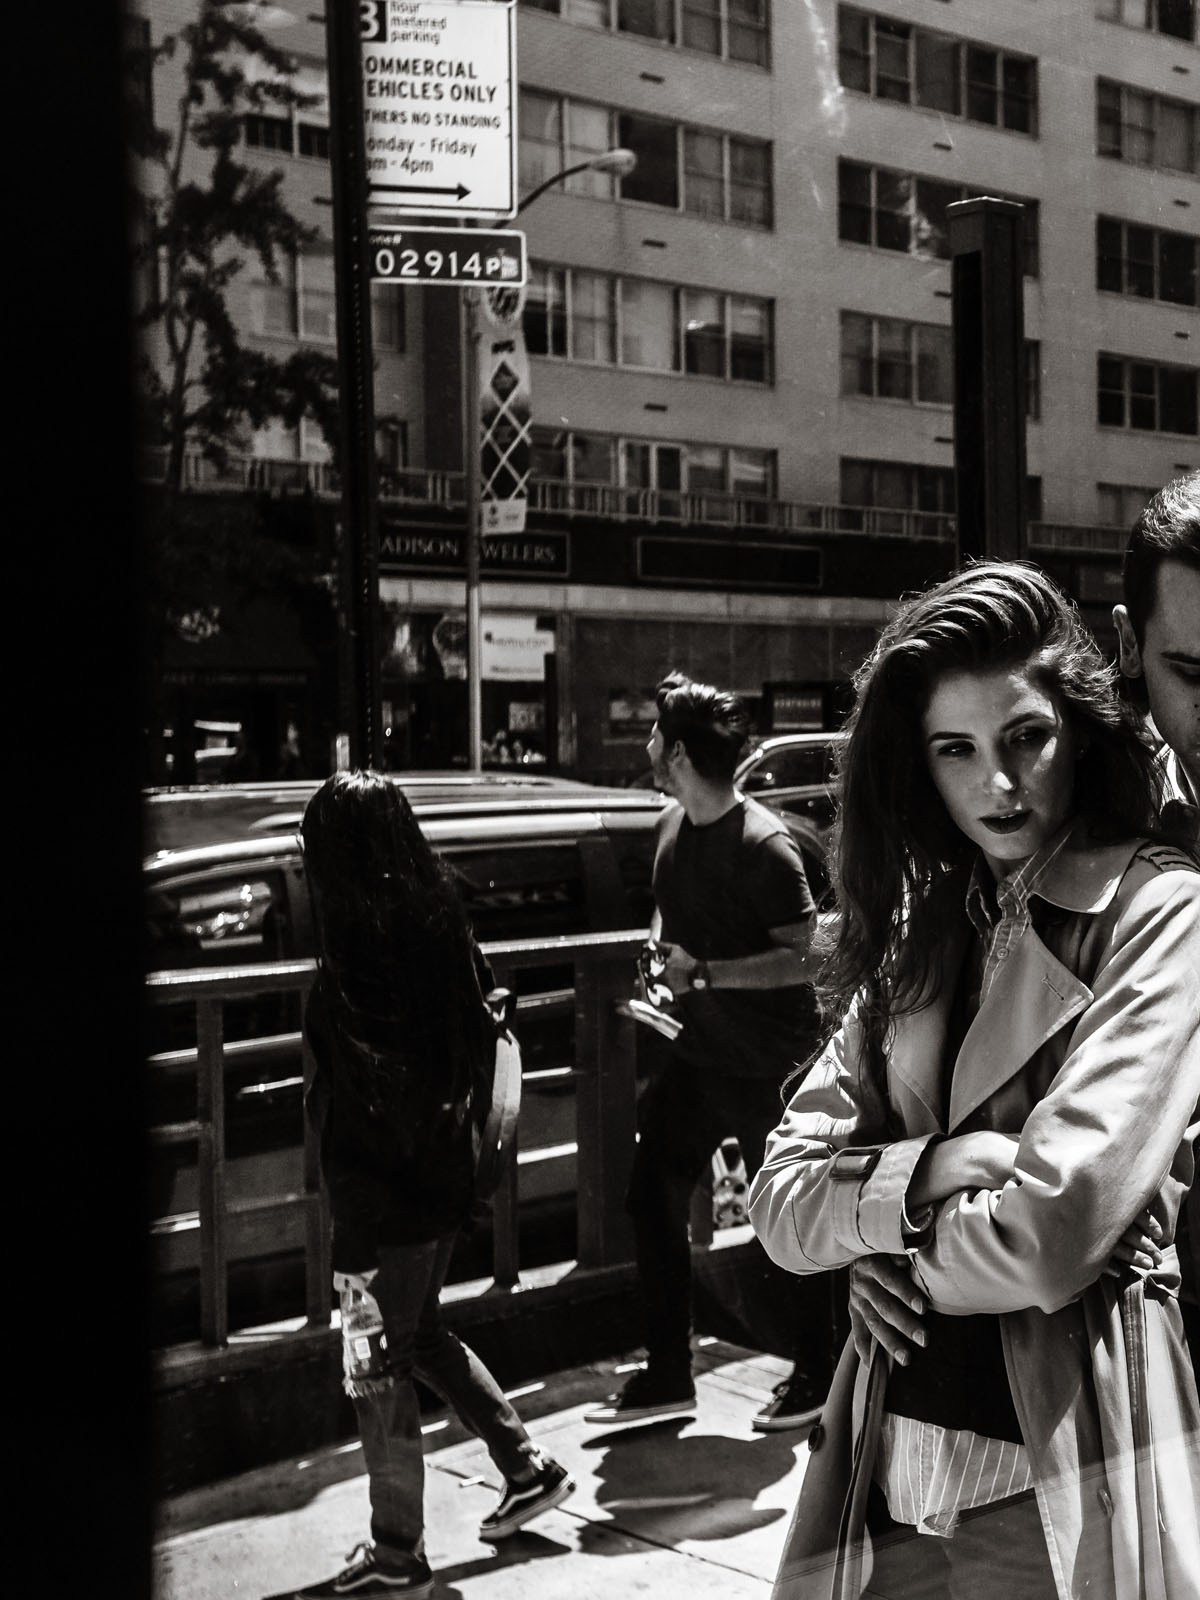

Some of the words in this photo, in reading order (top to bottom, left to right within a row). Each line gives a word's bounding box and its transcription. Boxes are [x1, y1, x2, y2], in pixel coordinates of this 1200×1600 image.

[391, 1, 420, 14] hour
[360, 1, 380, 39] 3
[391, 16, 447, 29] metered
[391, 30, 441, 45] parking
[365, 55, 478, 79] OMMERCIAL
[365, 78, 444, 101] EHICLES
[450, 83, 497, 102] ONLY
[364, 107, 407, 125] THERS
[411, 111, 431, 126] NO
[434, 112, 501, 129] STANDING
[366, 135, 415, 154] onday
[430, 137, 477, 158] Friday
[366, 156, 387, 172] am
[400, 155, 434, 176] 4pm
[368, 233, 402, 247] one#
[380, 536, 459, 557] ADISON
[481, 539, 557, 562] WELERS
